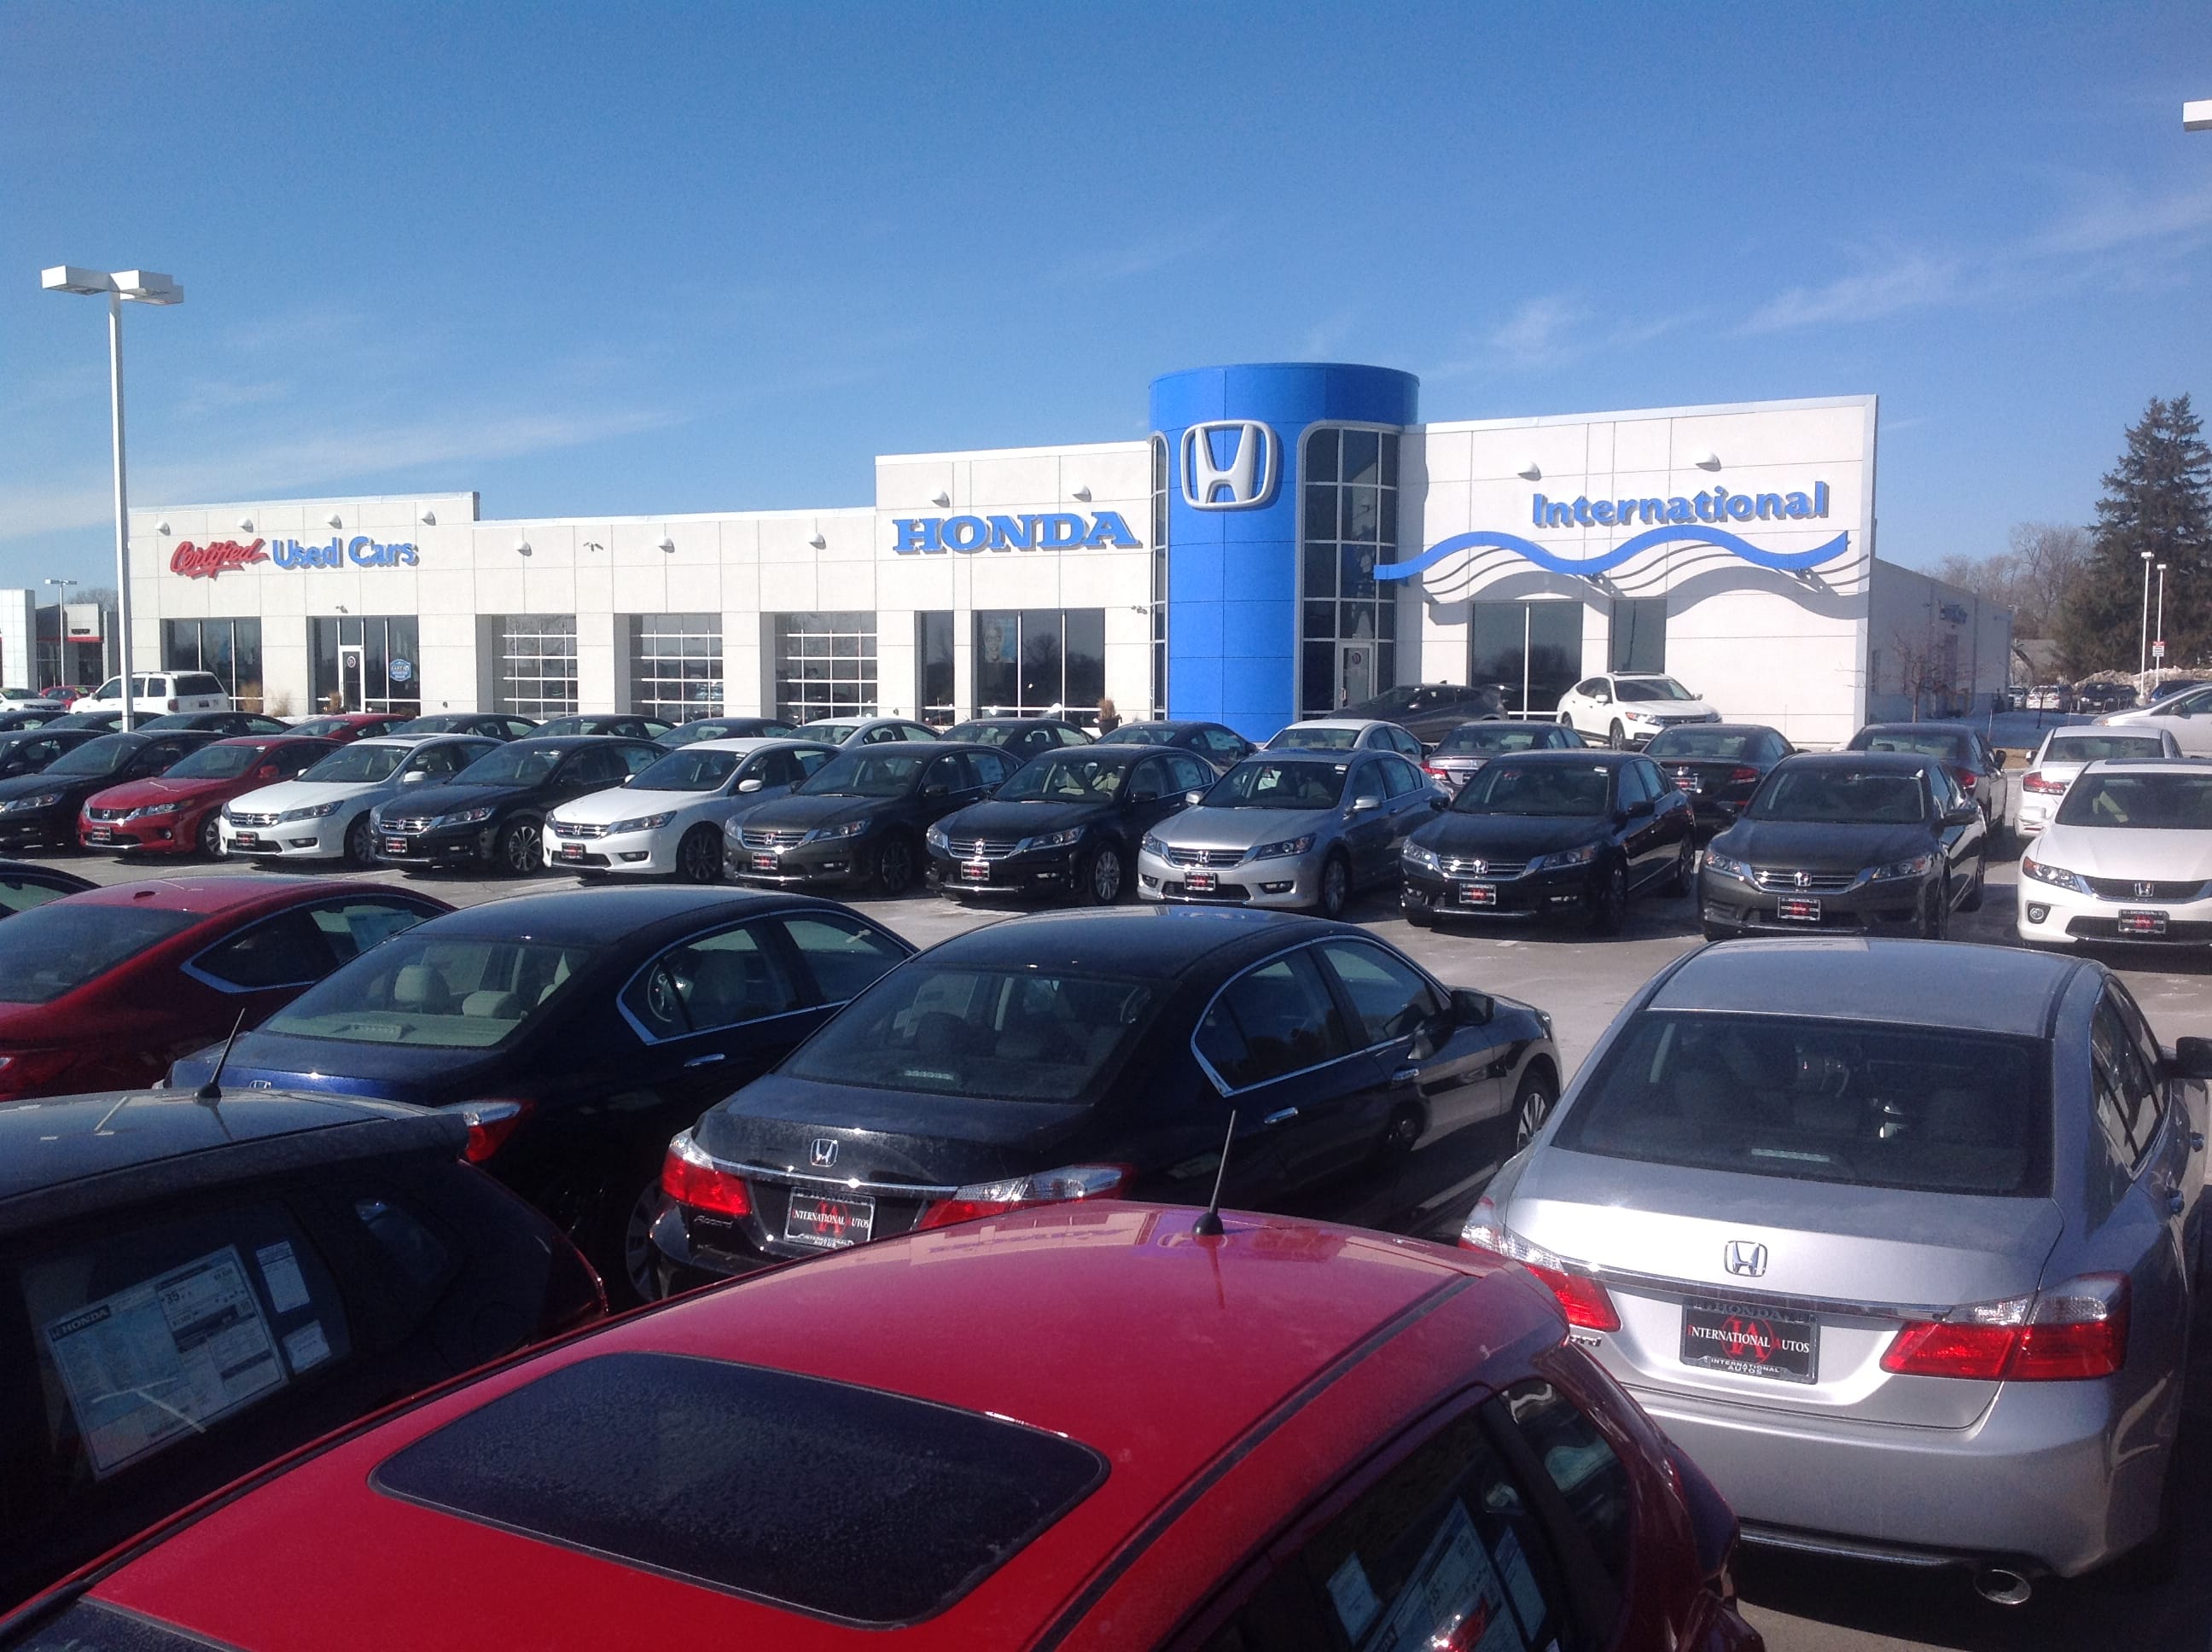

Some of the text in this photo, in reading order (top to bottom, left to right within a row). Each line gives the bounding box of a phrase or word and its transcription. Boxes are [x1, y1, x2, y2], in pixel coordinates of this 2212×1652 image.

[1532, 480, 1828, 526] International
[892, 510, 1140, 553] HONDA
[171, 536, 419, 579] Certified Used Cars
[792, 1208, 870, 1229] INTERNATIONAL AUTOS
[61, 1306, 109, 1335] HONDA
[1687, 1324, 1810, 1353] INTERNATIONAL AUTOS
[1711, 1358, 1780, 1373] INTERNATIONAL
[1727, 1365, 1763, 1375] AUTOS
